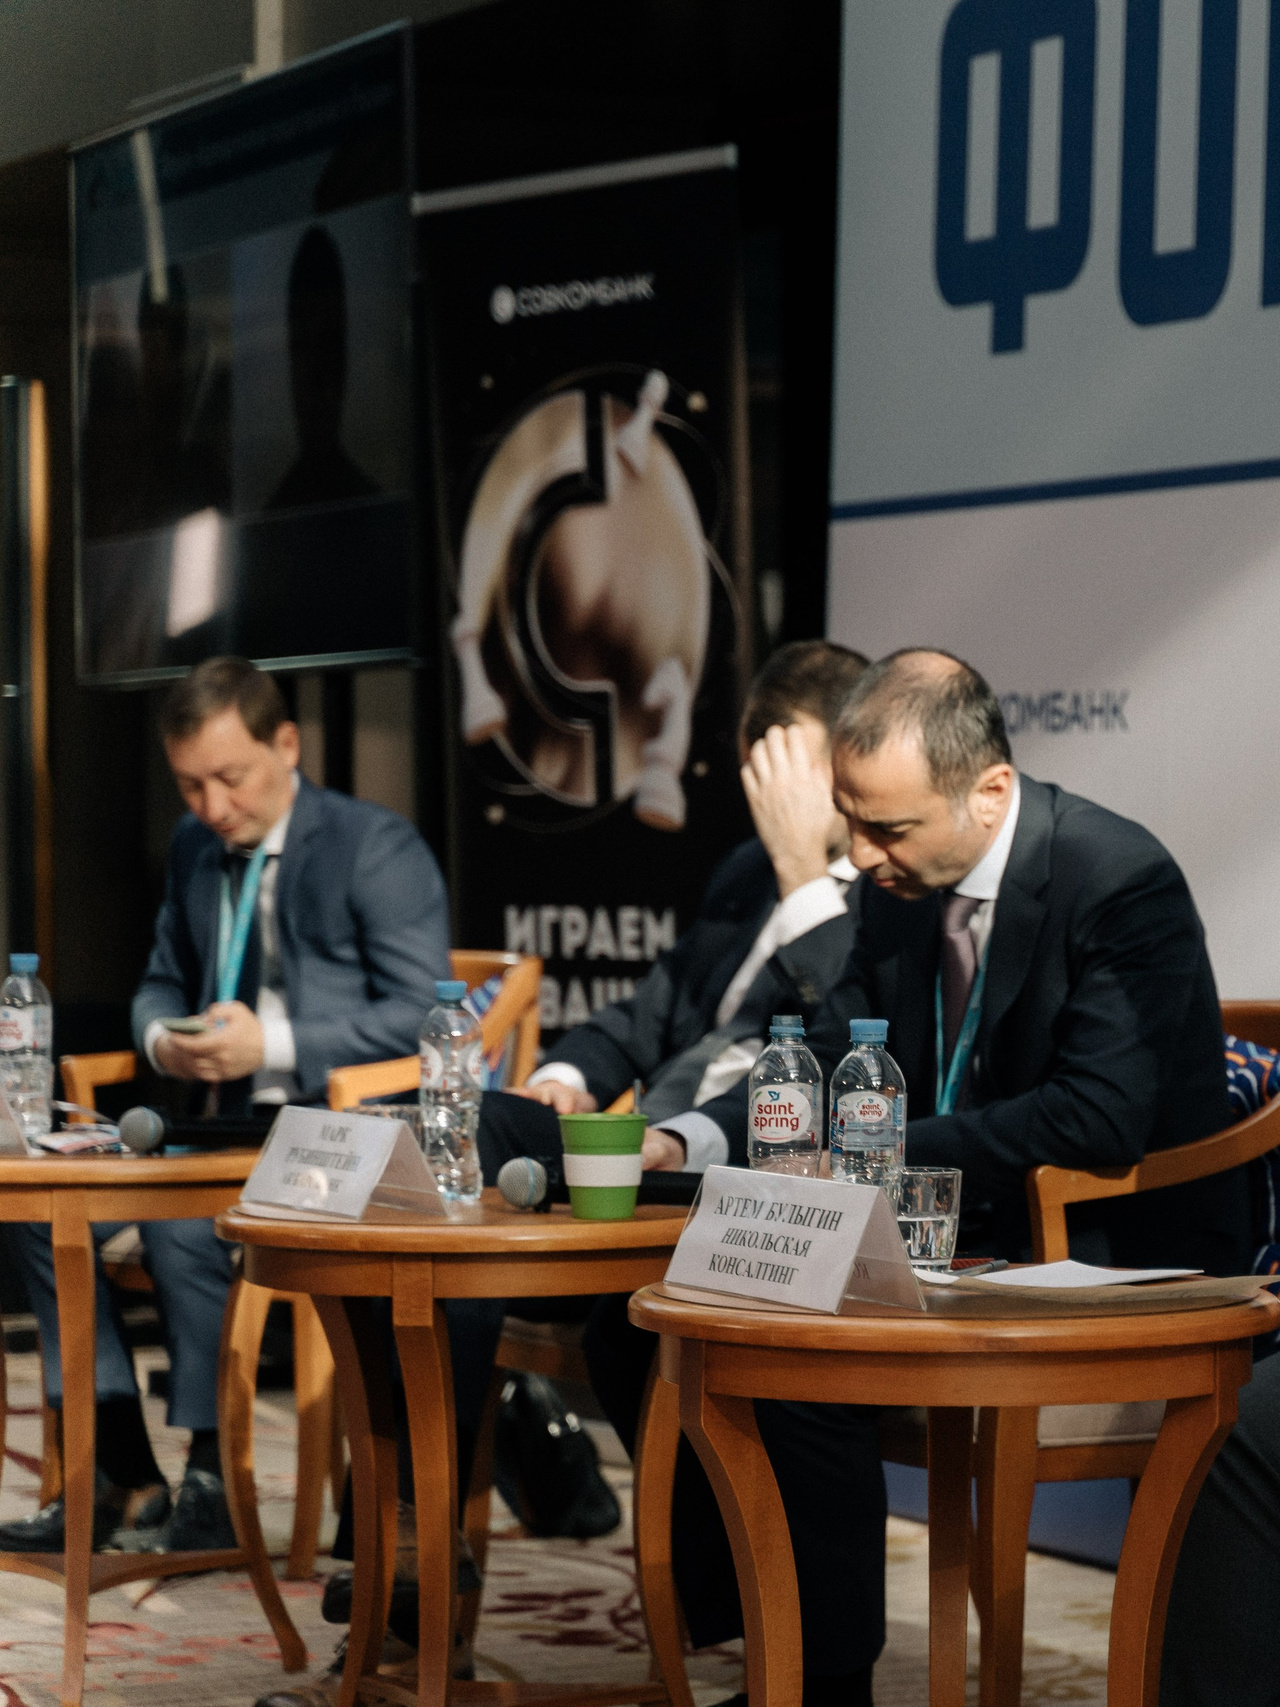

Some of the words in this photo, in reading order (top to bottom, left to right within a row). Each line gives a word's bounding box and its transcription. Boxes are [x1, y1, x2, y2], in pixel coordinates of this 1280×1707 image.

[504, 904, 677, 960] ИГРАЕМ
[757, 1102, 795, 1115] saint
[859, 1108, 883, 1118] spring
[861, 1102, 880, 1110] saint
[753, 1115, 800, 1131] spring
[714, 1196, 764, 1219] АРТЕМ
[765, 1202, 843, 1231] БУЛЫГИН
[721, 1227, 812, 1257] НИКОЛЬСКАЯ
[708, 1253, 799, 1285] КОНСАЛТИНГ
